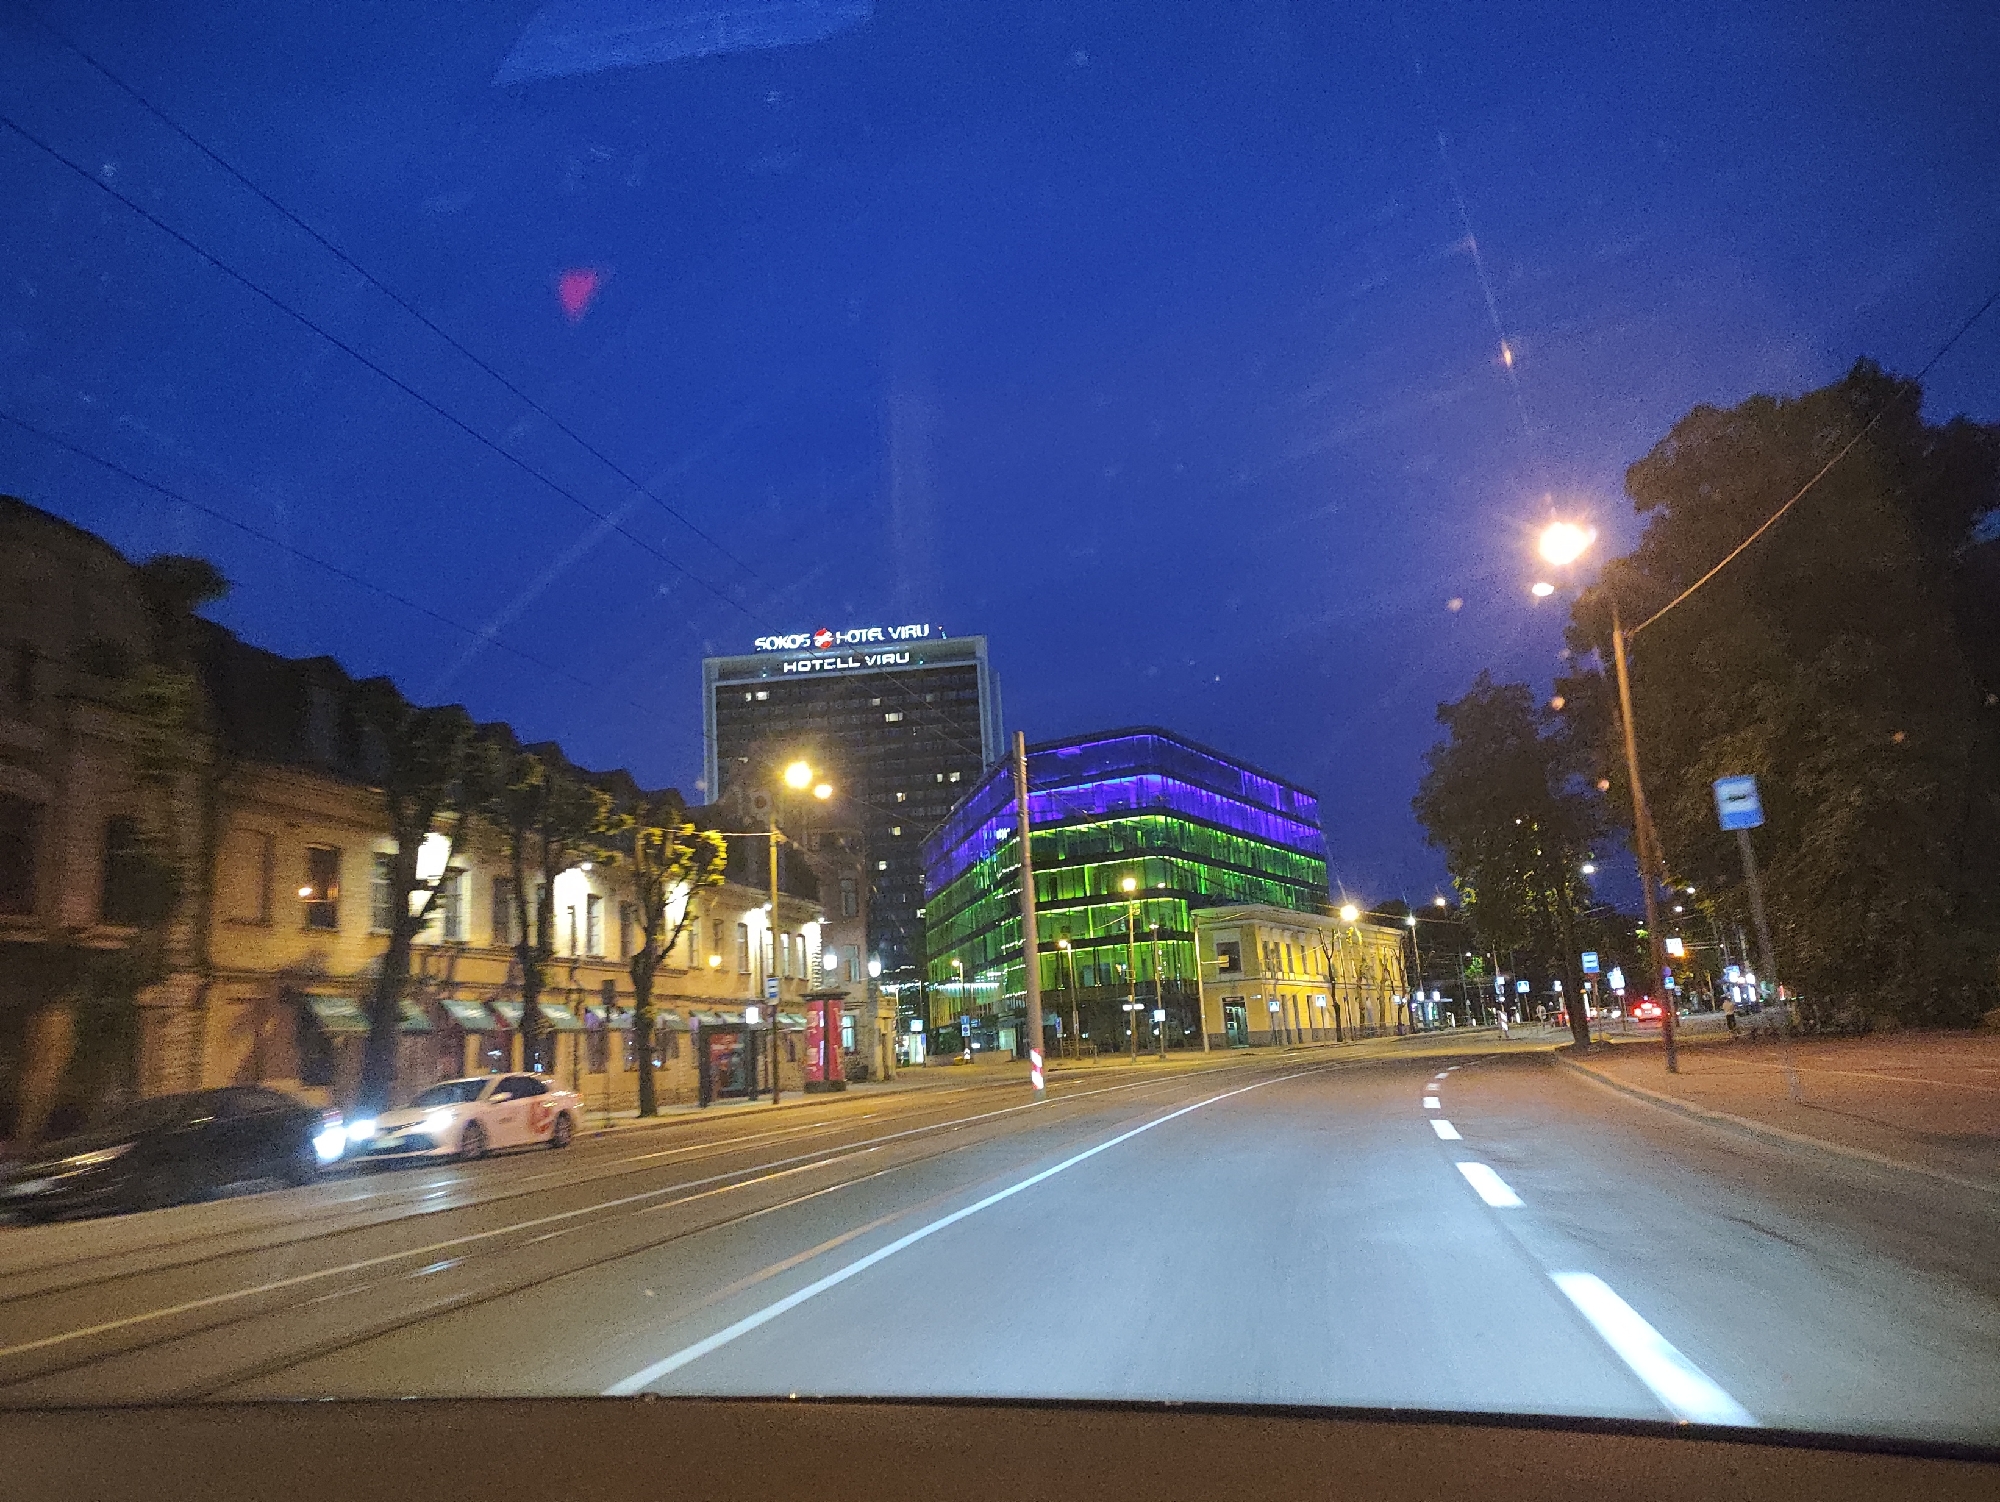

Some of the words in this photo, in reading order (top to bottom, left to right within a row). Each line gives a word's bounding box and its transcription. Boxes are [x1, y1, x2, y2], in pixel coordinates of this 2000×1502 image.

[754, 633, 811, 651] SOKOS
[836, 627, 886, 645] HOTEL
[888, 623, 930, 640] VIRU
[783, 656, 861, 673] HOTELL
[865, 652, 910, 666] VIRU
